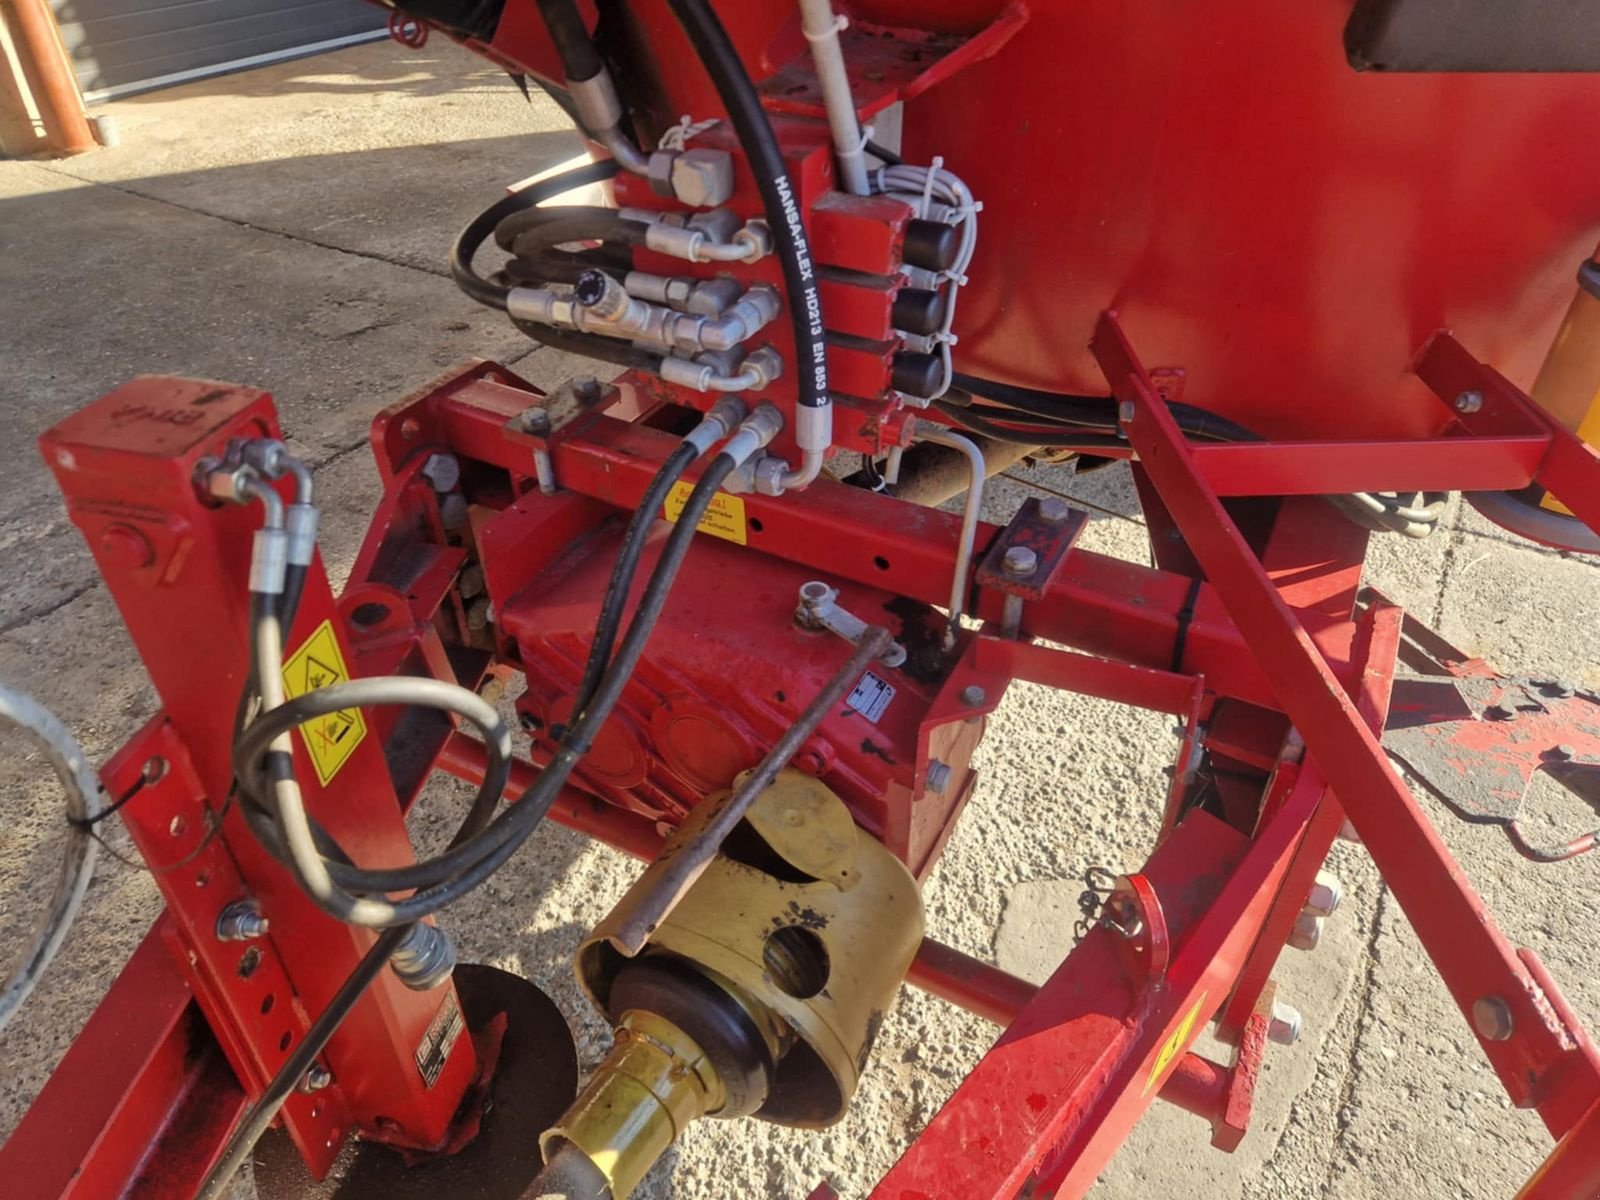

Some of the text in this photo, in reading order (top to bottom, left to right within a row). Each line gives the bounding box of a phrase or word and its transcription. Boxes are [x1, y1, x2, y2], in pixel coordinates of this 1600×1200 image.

[775, 175, 827, 407] HANSA-FLEX HD213 EN 853 2
